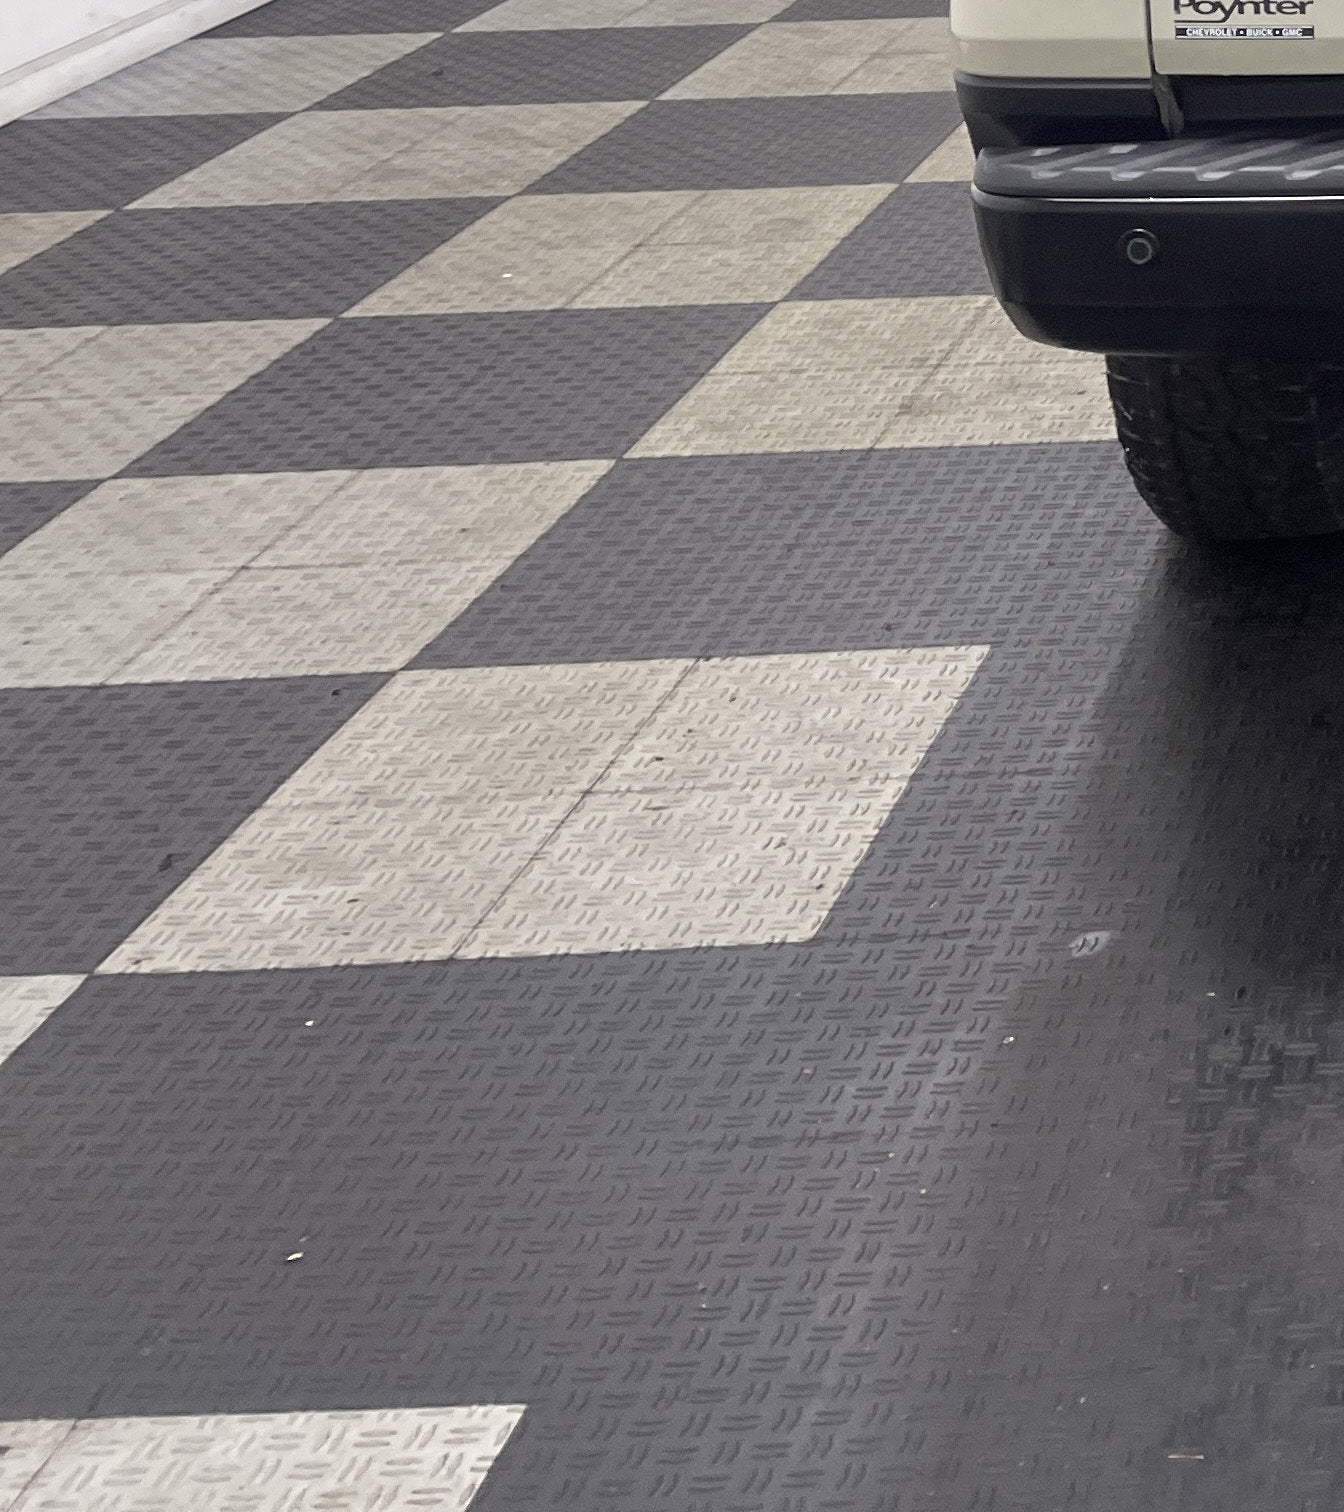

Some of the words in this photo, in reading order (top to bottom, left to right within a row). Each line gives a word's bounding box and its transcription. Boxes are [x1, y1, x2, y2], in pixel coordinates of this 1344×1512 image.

[1186, 27, 1238, 36] CHEVROLET
[1246, 27, 1273, 36] BUICK
[1282, 27, 1303, 36] GMC
